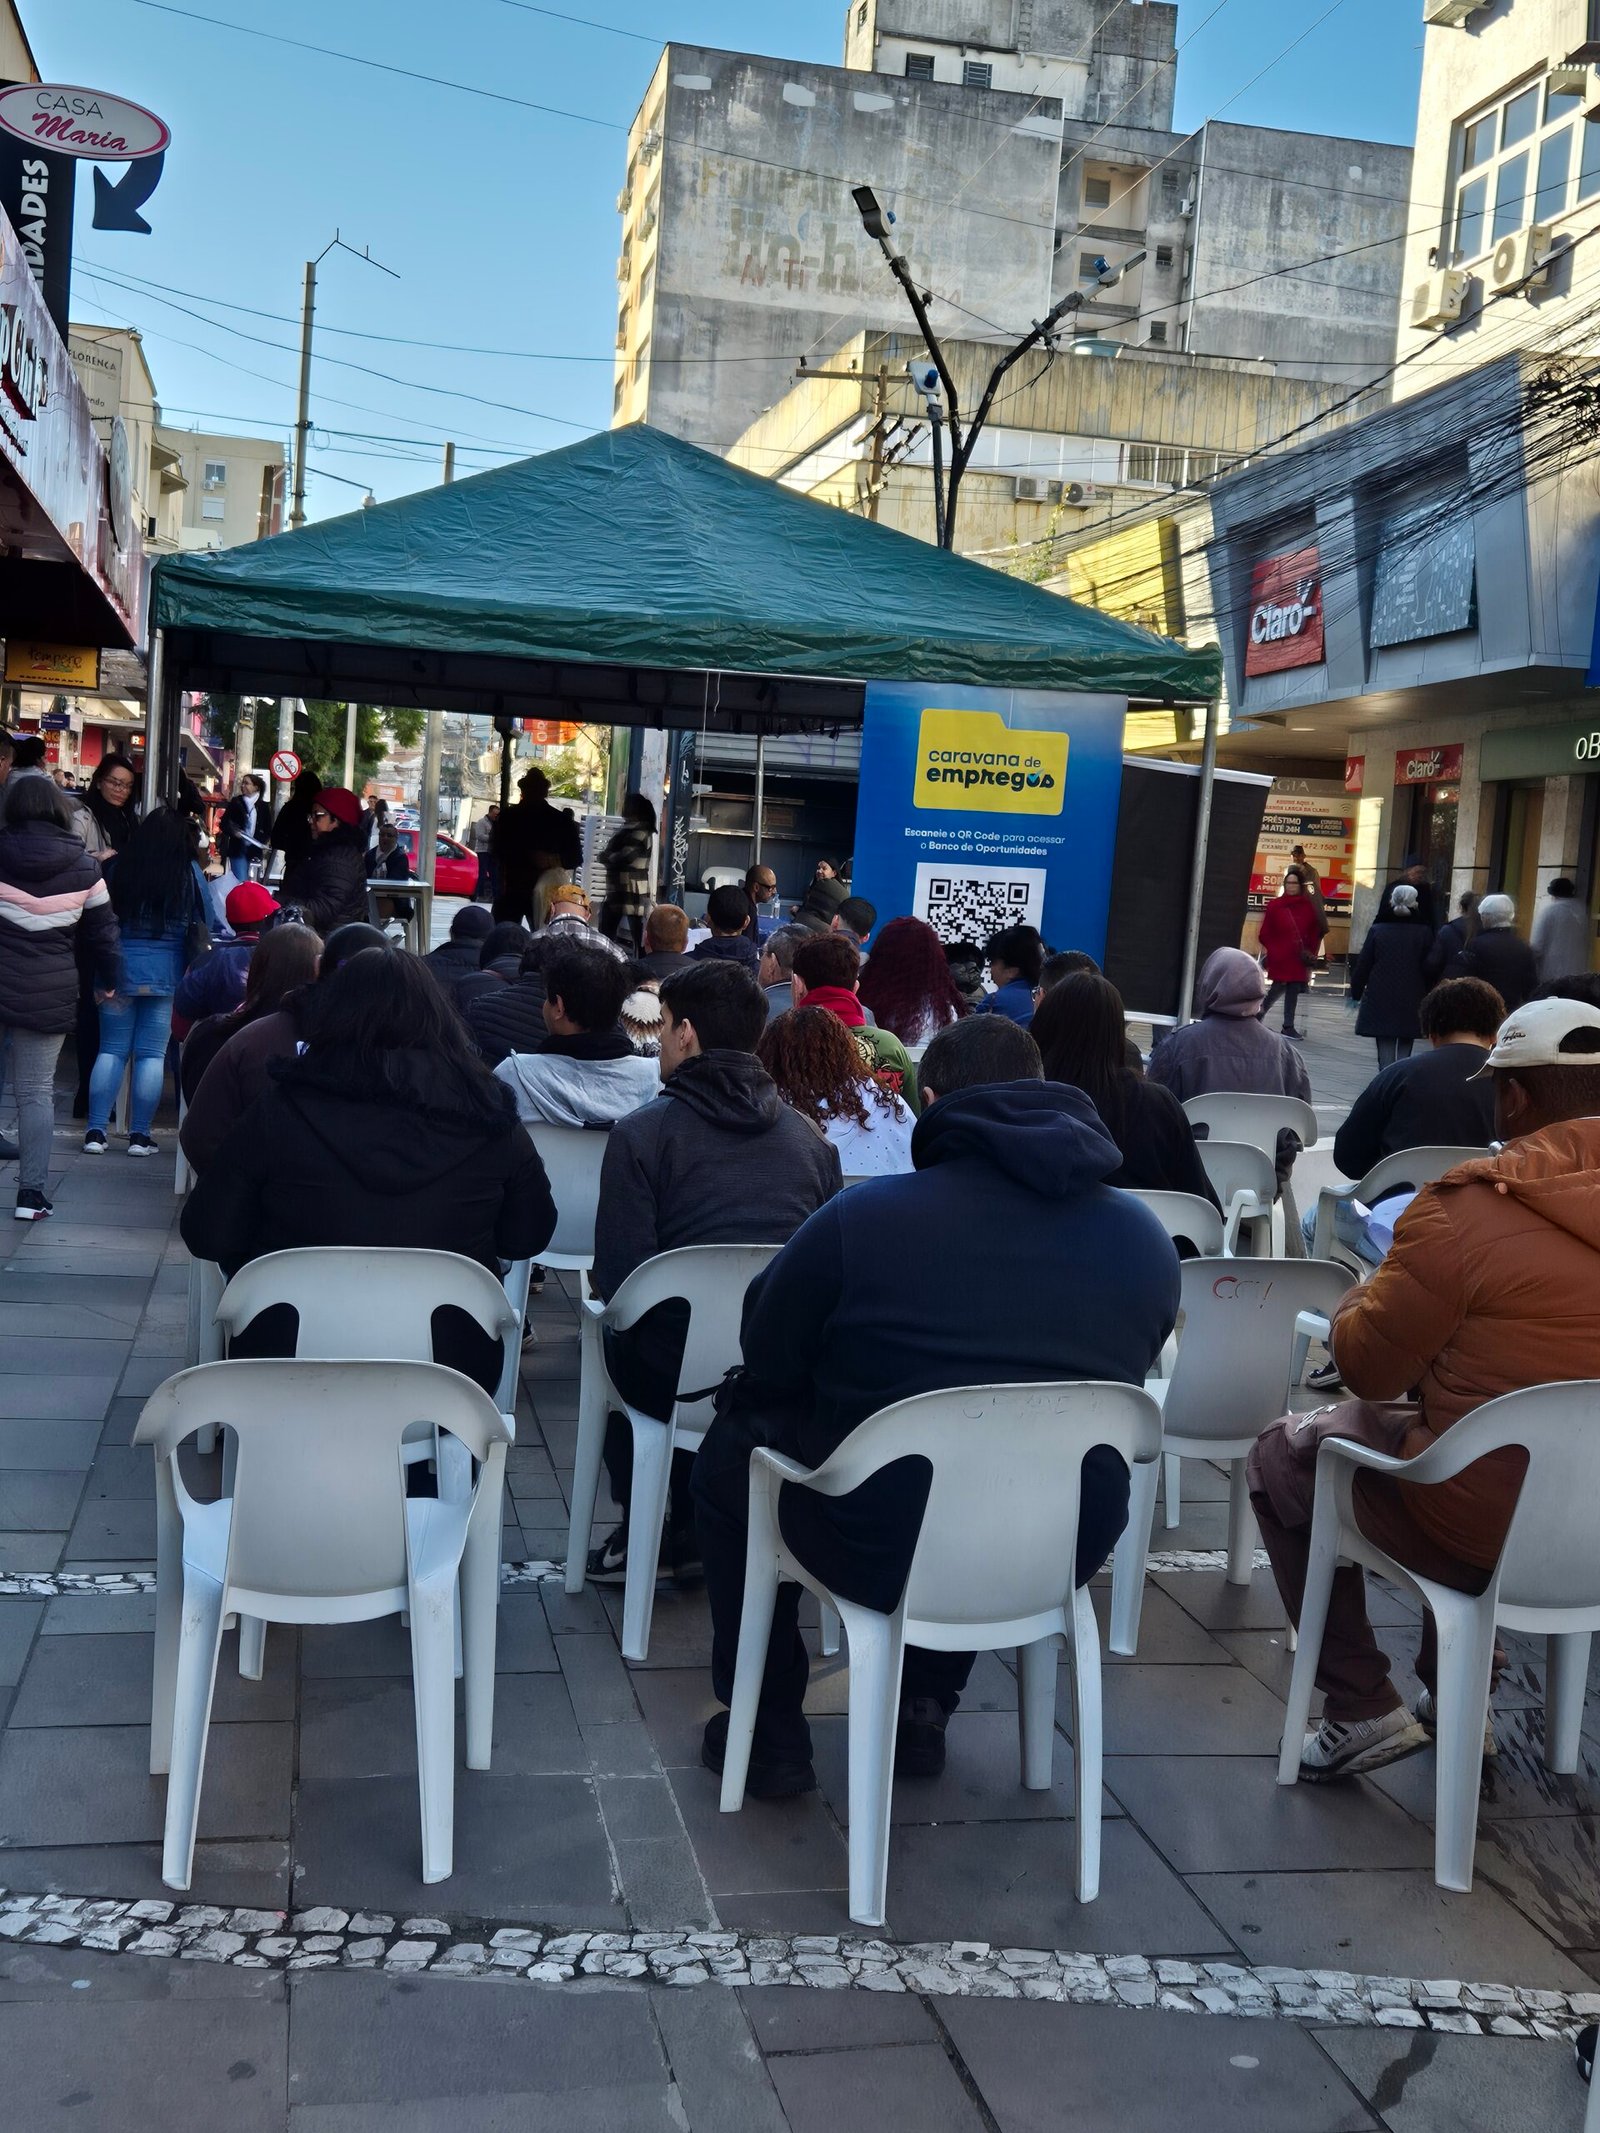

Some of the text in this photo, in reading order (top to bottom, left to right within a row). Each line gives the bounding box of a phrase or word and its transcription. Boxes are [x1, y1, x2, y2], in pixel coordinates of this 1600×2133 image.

[36, 92, 104, 119] CASA
[32, 112, 129, 151] Maria
[1251, 601, 1304, 645] Claro
[928, 750, 1042, 768] caravana de
[1406, 759, 1435, 779] Claro
[926, 767, 1055, 792] empregos
[904, 827, 948, 839] Escaneie
[957, 830, 972, 840] QR
[974, 831, 1000, 841] Code
[1002, 834, 1025, 843] para
[1027, 835, 1066, 844] acessar
[928, 841, 959, 851] Banco
[961, 842, 973, 851] de
[975, 843, 1048, 856] Oportunidades
